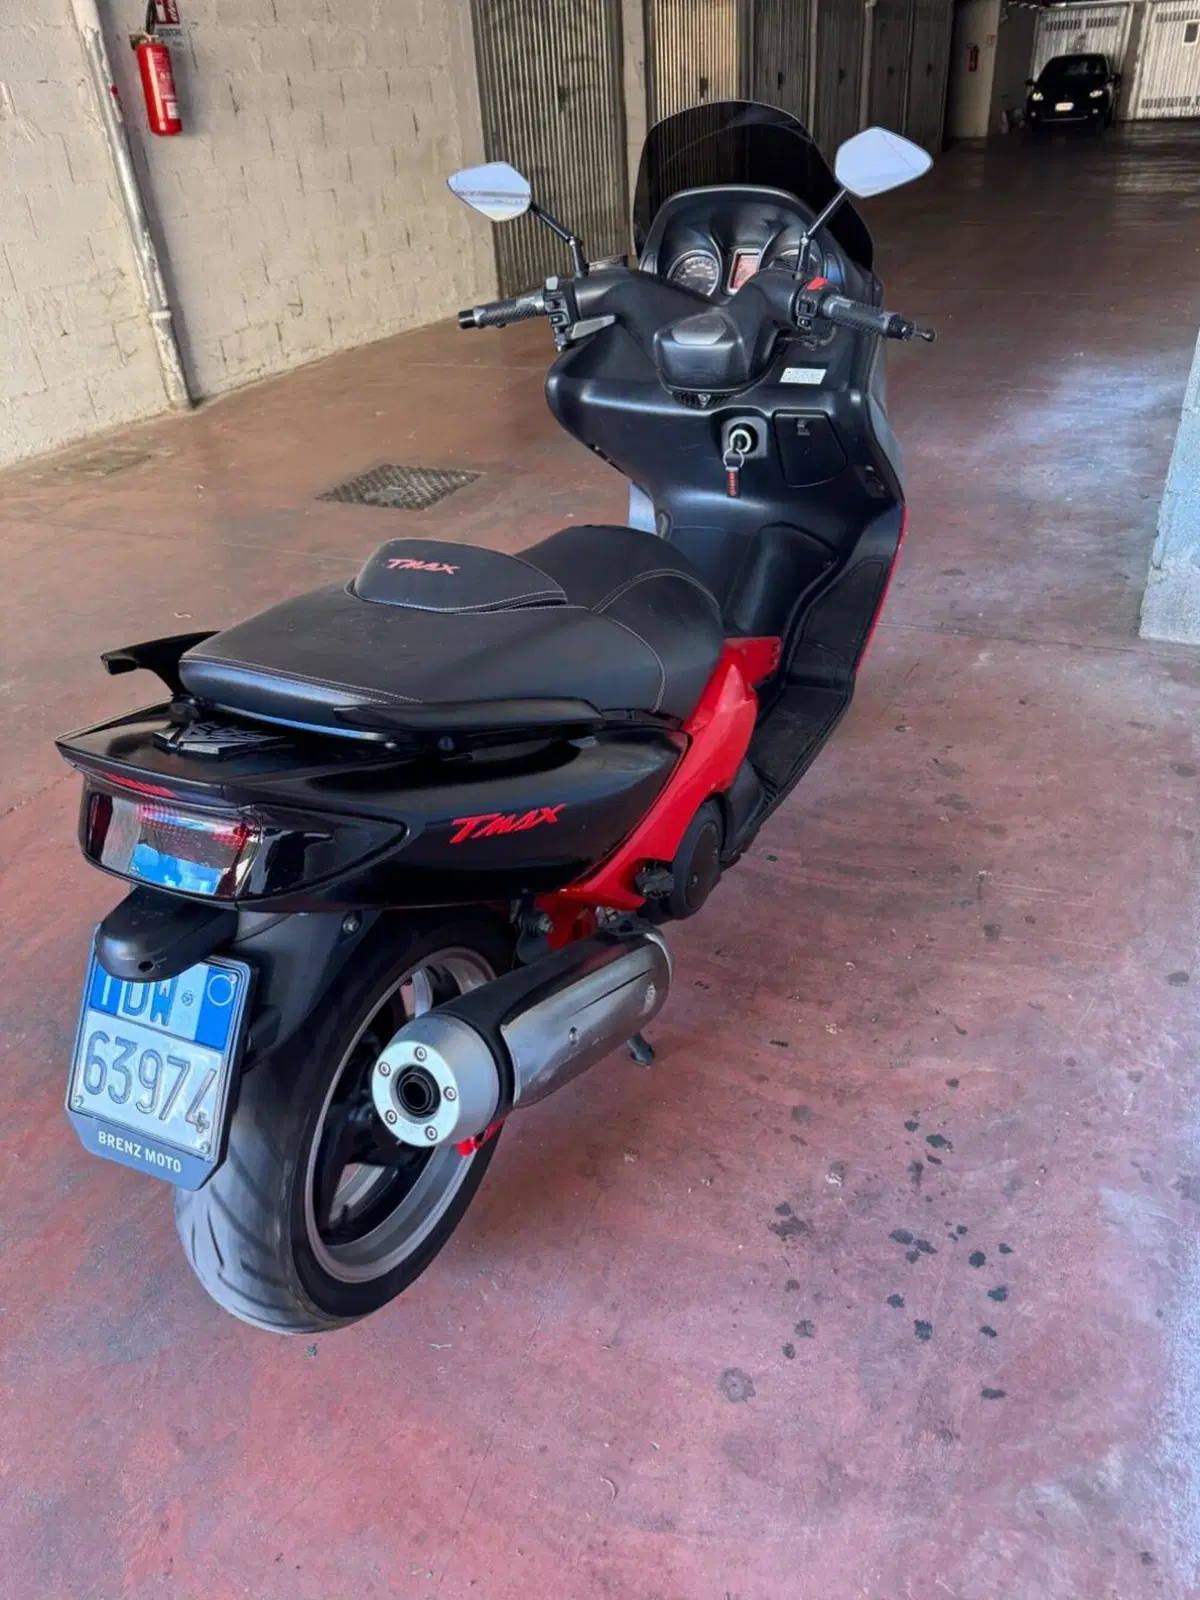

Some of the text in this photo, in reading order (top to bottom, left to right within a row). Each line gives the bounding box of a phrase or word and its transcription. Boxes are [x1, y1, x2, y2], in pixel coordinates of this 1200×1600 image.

[83, 1031, 217, 1134] 63974
[98, 1130, 182, 1173] BRENZ MOTO
